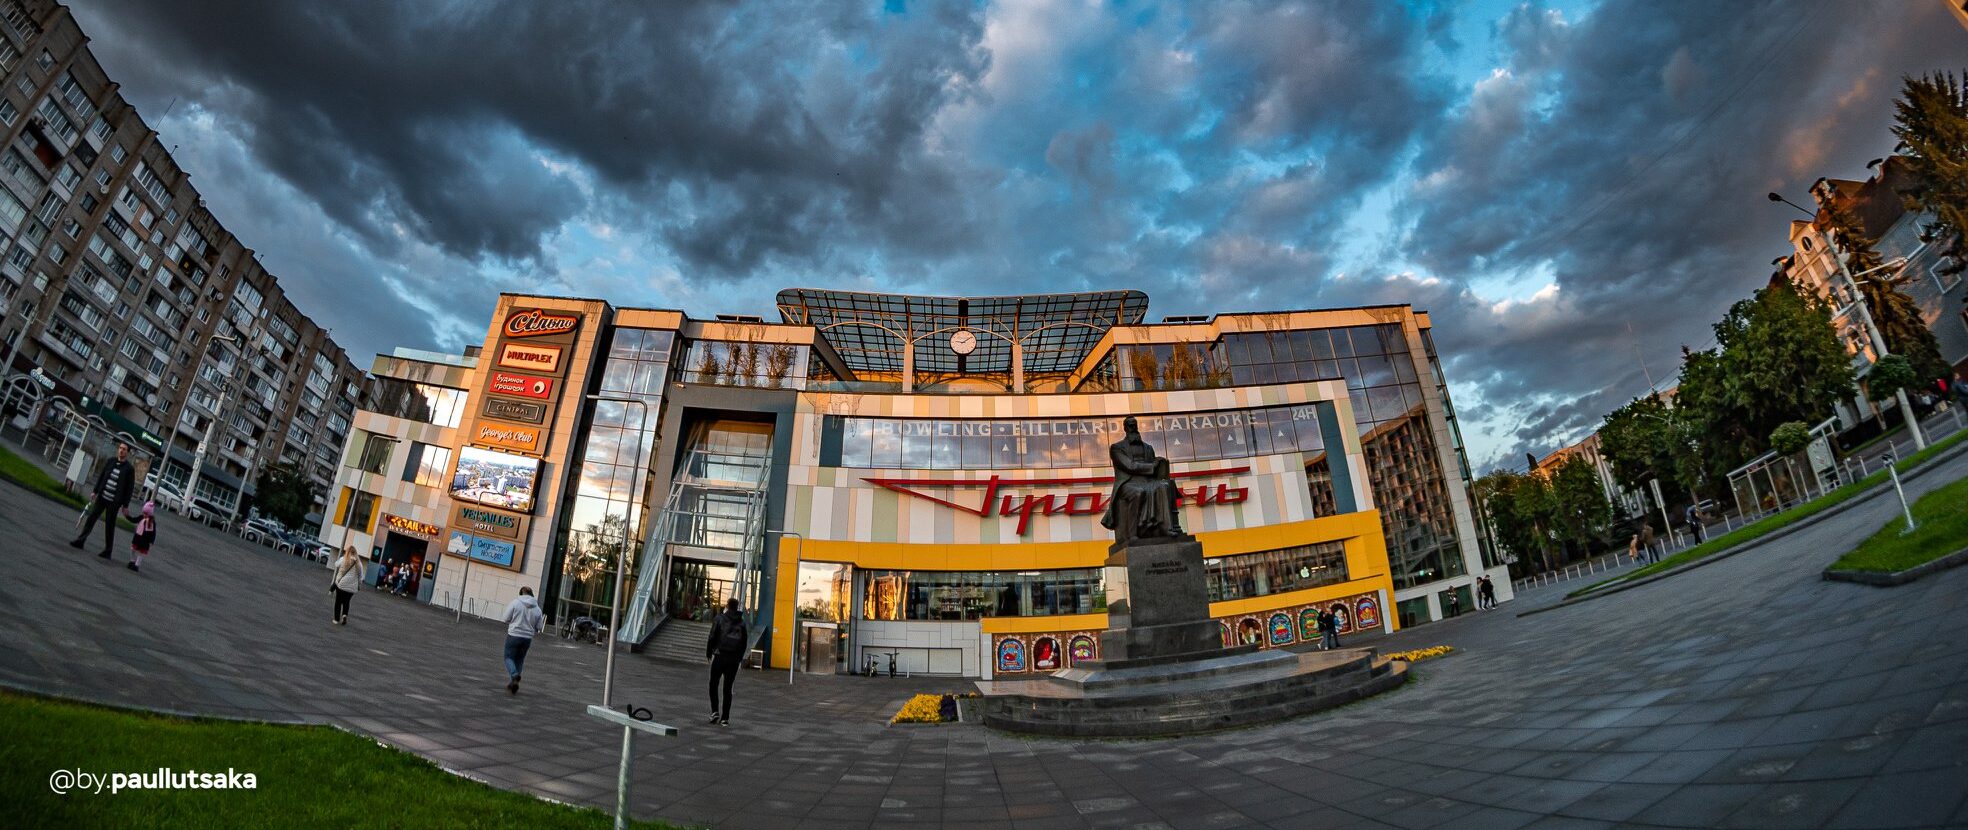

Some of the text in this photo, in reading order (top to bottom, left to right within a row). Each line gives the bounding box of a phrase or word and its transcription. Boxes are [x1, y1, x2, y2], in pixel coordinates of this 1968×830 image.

[509, 312, 574, 333] Сільпо
[507, 350, 553, 364] MULTIPLEX
[1292, 406, 1319, 421] 24H
[881, 411, 1257, 437] BOWLING BILLIARD KARAOKE
[513, 430, 533, 443] Club
[462, 507, 515, 528] VERSAILLES
[474, 522, 495, 532] HOTEL
